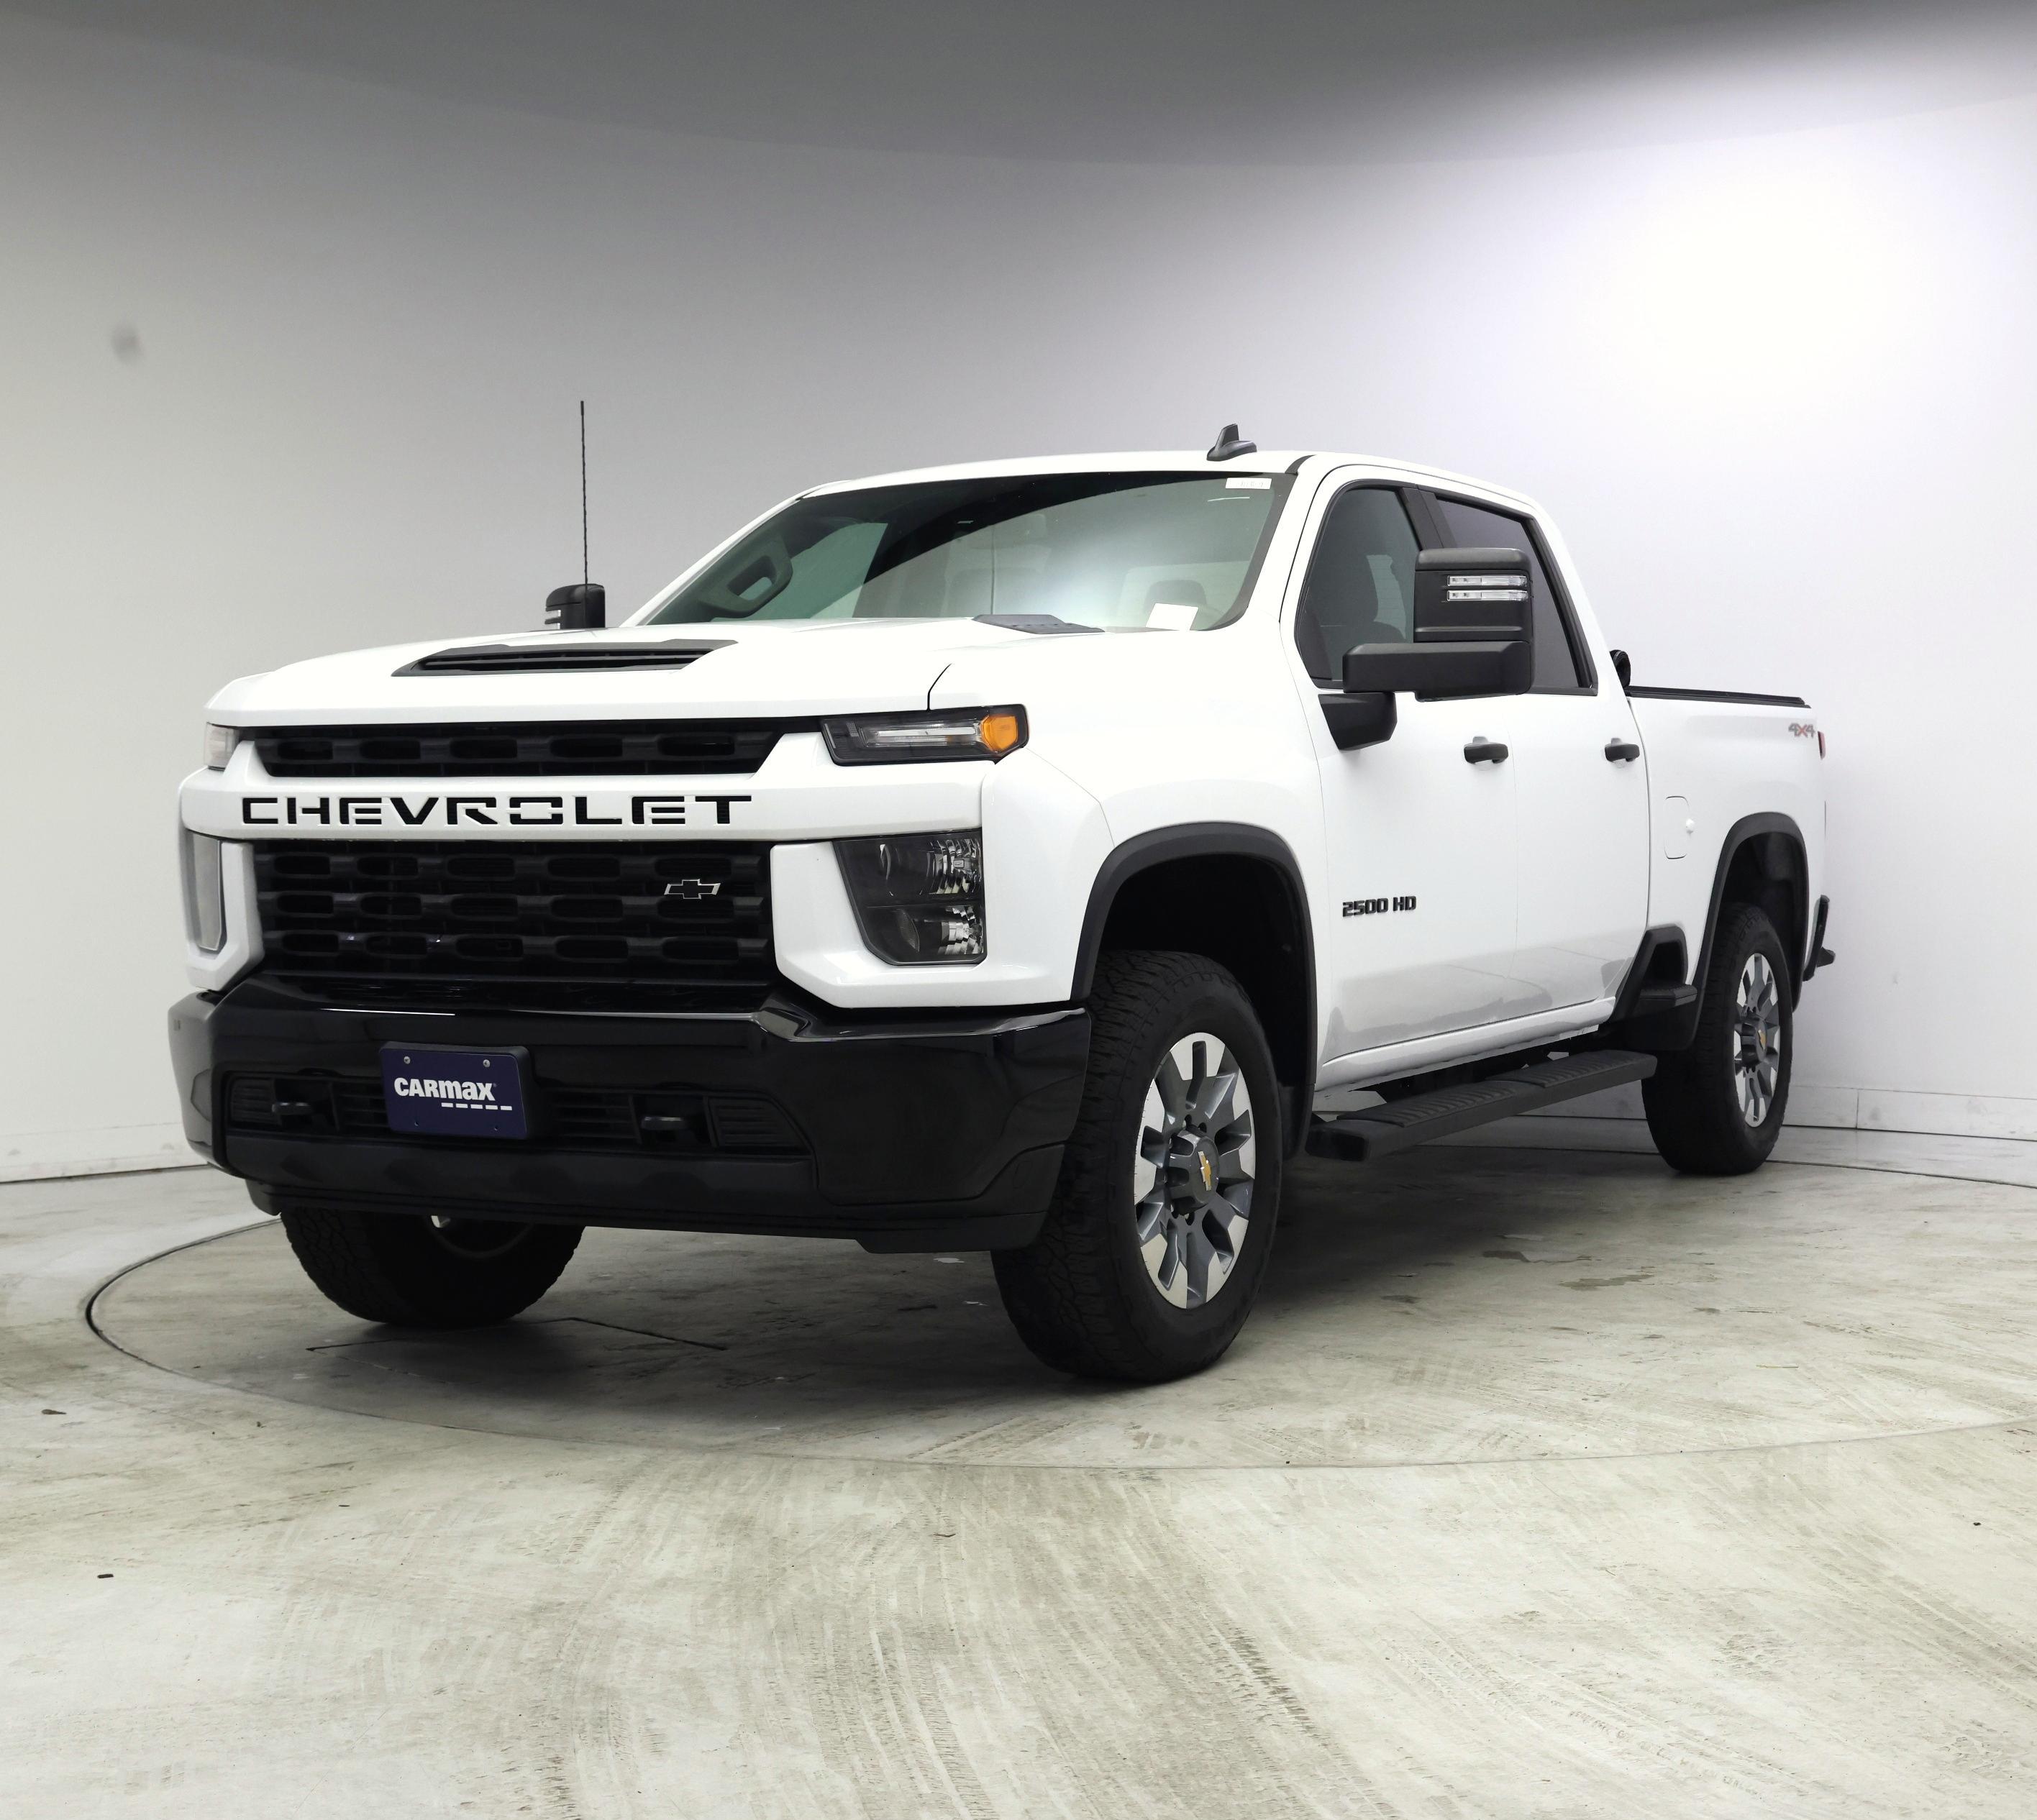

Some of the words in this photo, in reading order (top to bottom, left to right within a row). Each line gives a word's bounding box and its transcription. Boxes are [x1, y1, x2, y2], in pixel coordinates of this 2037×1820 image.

[242, 795, 752, 826] CHEVROLET
[1342, 898, 1388, 917] 2500
[1393, 896, 1416, 911] HD
